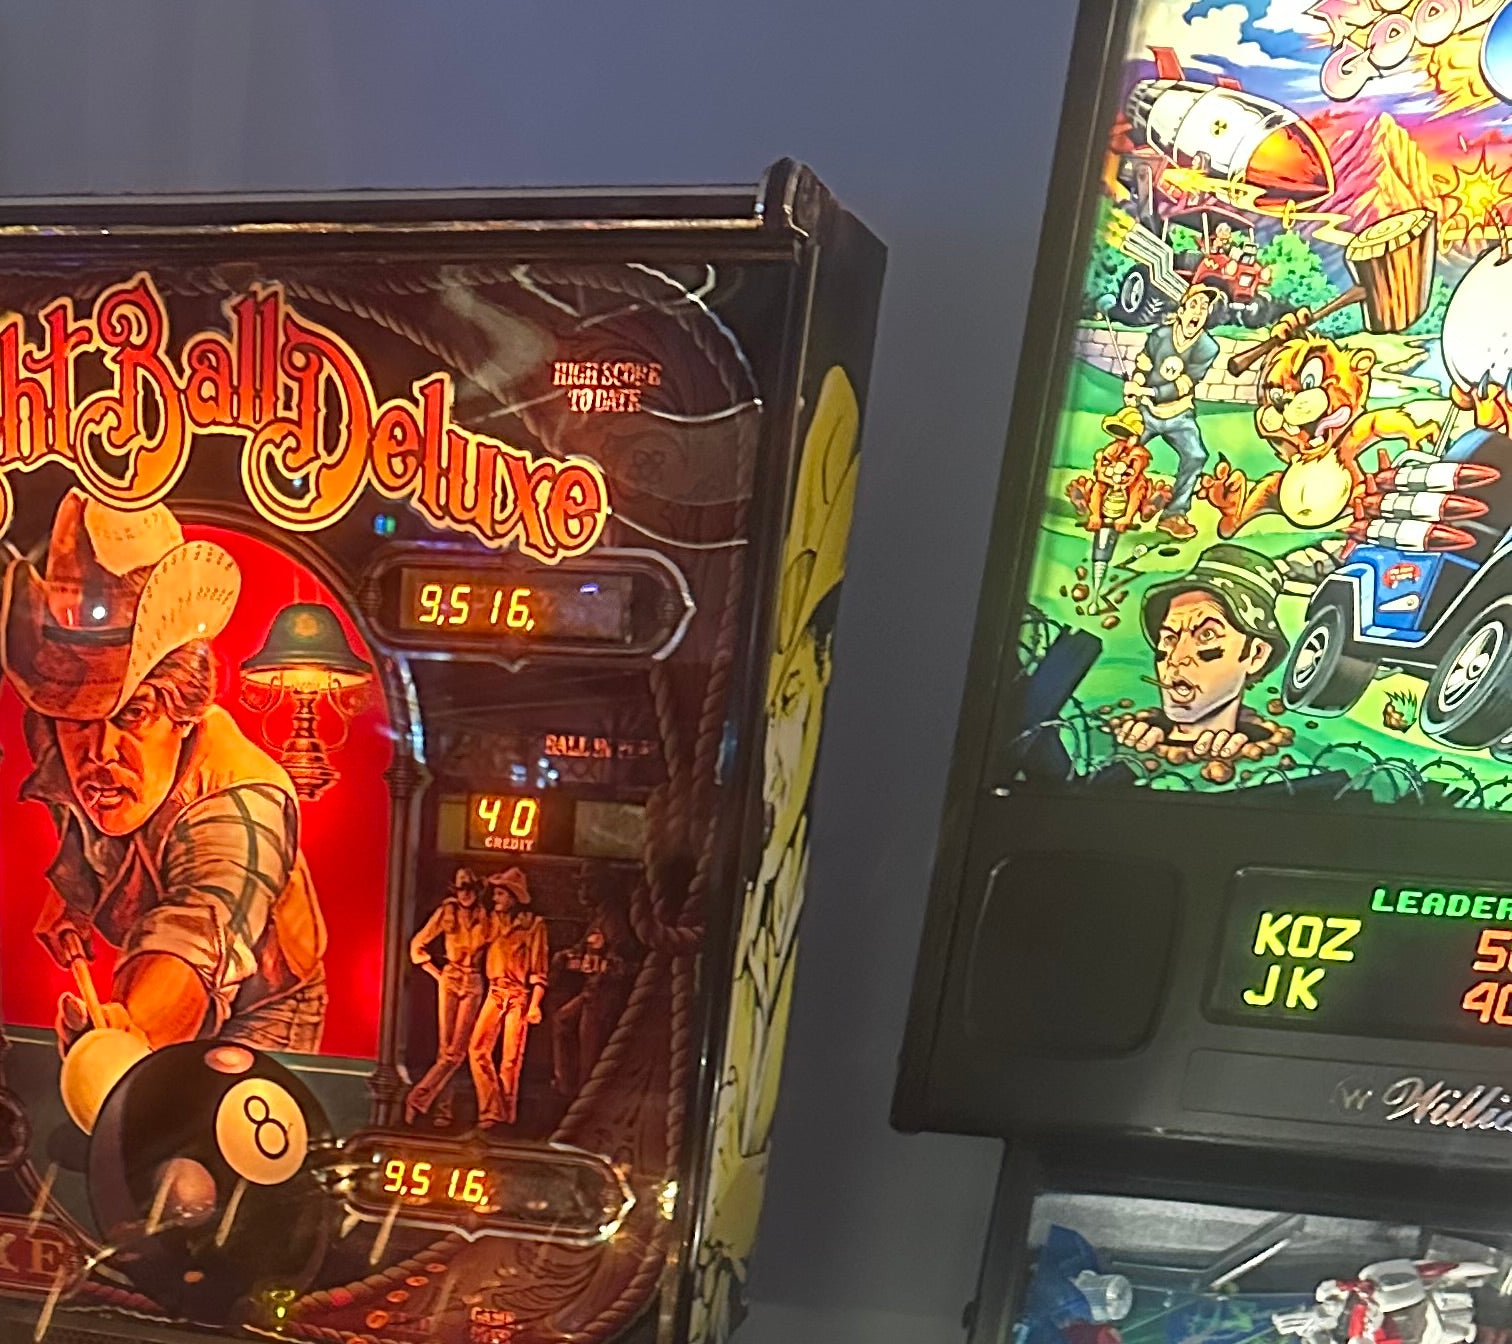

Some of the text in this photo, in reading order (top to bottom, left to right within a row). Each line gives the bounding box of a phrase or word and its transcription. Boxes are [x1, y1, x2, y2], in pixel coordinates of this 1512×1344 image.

[552, 361, 663, 387] HIGH SCORE
[74, 271, 285, 512] Ball
[241, 303, 609, 566] Deluxe
[568, 388, 643, 412] TO DATE
[485, 836, 534, 851] CREDIT
[1254, 912, 1512, 973] KOZ 5
[244, 1095, 288, 1160] 8
